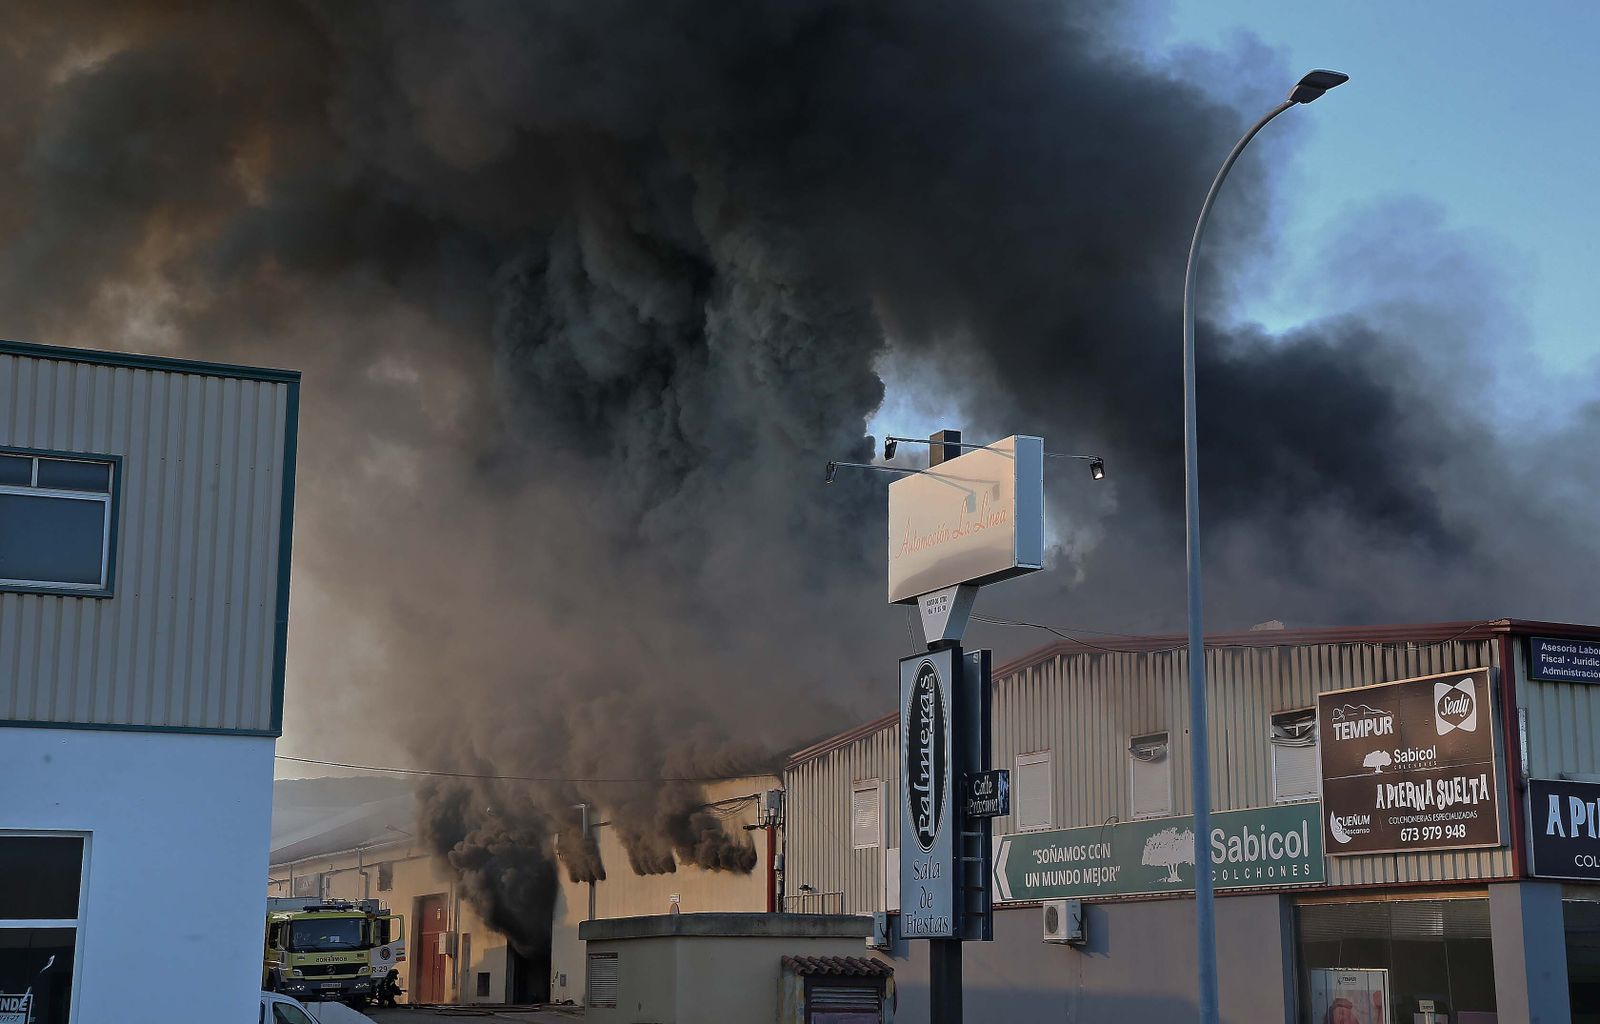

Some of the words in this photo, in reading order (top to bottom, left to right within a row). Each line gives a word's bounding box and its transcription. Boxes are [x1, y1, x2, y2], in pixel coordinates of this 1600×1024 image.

[952, 498, 970, 539] La
[1541, 654, 1565, 664] Fiscal
[1441, 694, 1470, 718] Sealy
[1332, 715, 1394, 741] TEMPUR
[912, 674, 932, 836] Palmeras
[1394, 745, 1436, 764] Sabicol
[974, 775, 993, 795] Calle
[1376, 784, 1386, 809] A
[1387, 779, 1435, 811] PIERNA
[1437, 773, 1490, 810] SUELTA
[1433, 810, 1478, 822] ESPECIALIZADAS
[1546, 794, 1566, 837] A
[1569, 796, 1600, 839] PI
[1211, 819, 1309, 864] Sabicol
[1400, 828, 1420, 842] 673
[1422, 825, 1442, 841] 979
[1445, 824, 1466, 839] 948
[1088, 843, 1111, 860] CON
[1574, 854, 1600, 868] COL
[913, 856, 940, 880] Sala
[1025, 872, 1040, 888] UN
[1042, 869, 1080, 887] MUNDO
[1212, 863, 1310, 881] COLCHONES
[920, 886, 933, 909] de
[905, 911, 949, 934] Fiestas
[0, 998, 28, 1011] NDE
